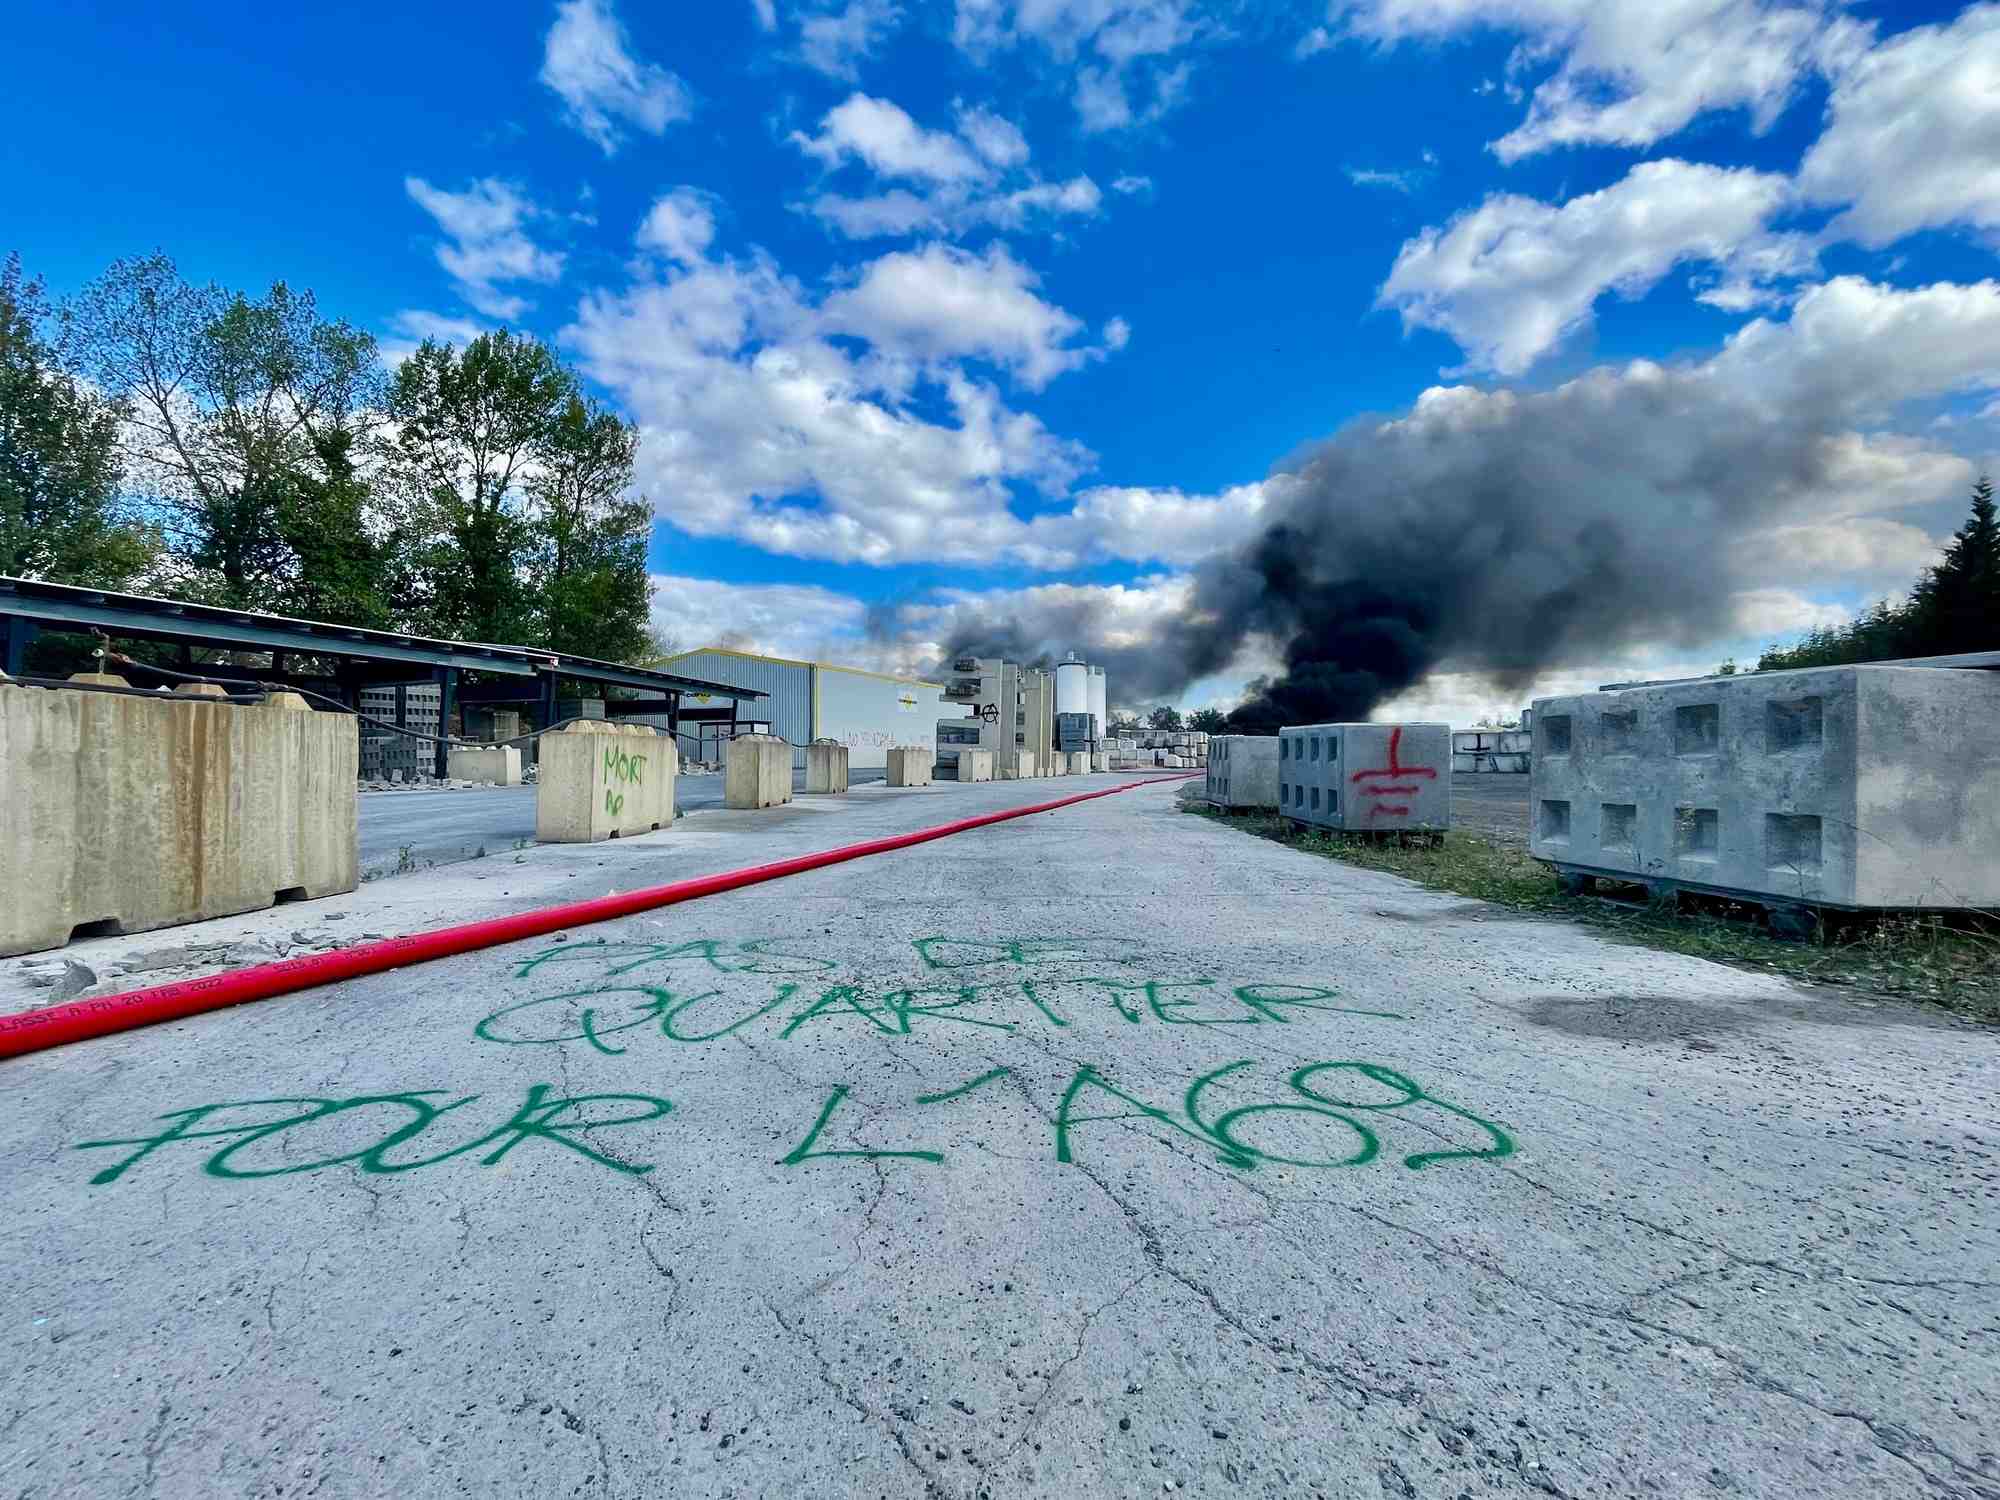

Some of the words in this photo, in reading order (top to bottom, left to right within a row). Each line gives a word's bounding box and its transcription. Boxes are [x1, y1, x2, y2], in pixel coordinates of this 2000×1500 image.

[603, 745, 647, 786] MORT
[512, 936, 836, 978] PAS
[912, 935, 1142, 969] DE
[477, 977, 1404, 1056] QUARTIER
[73, 1083, 674, 1186] POUR
